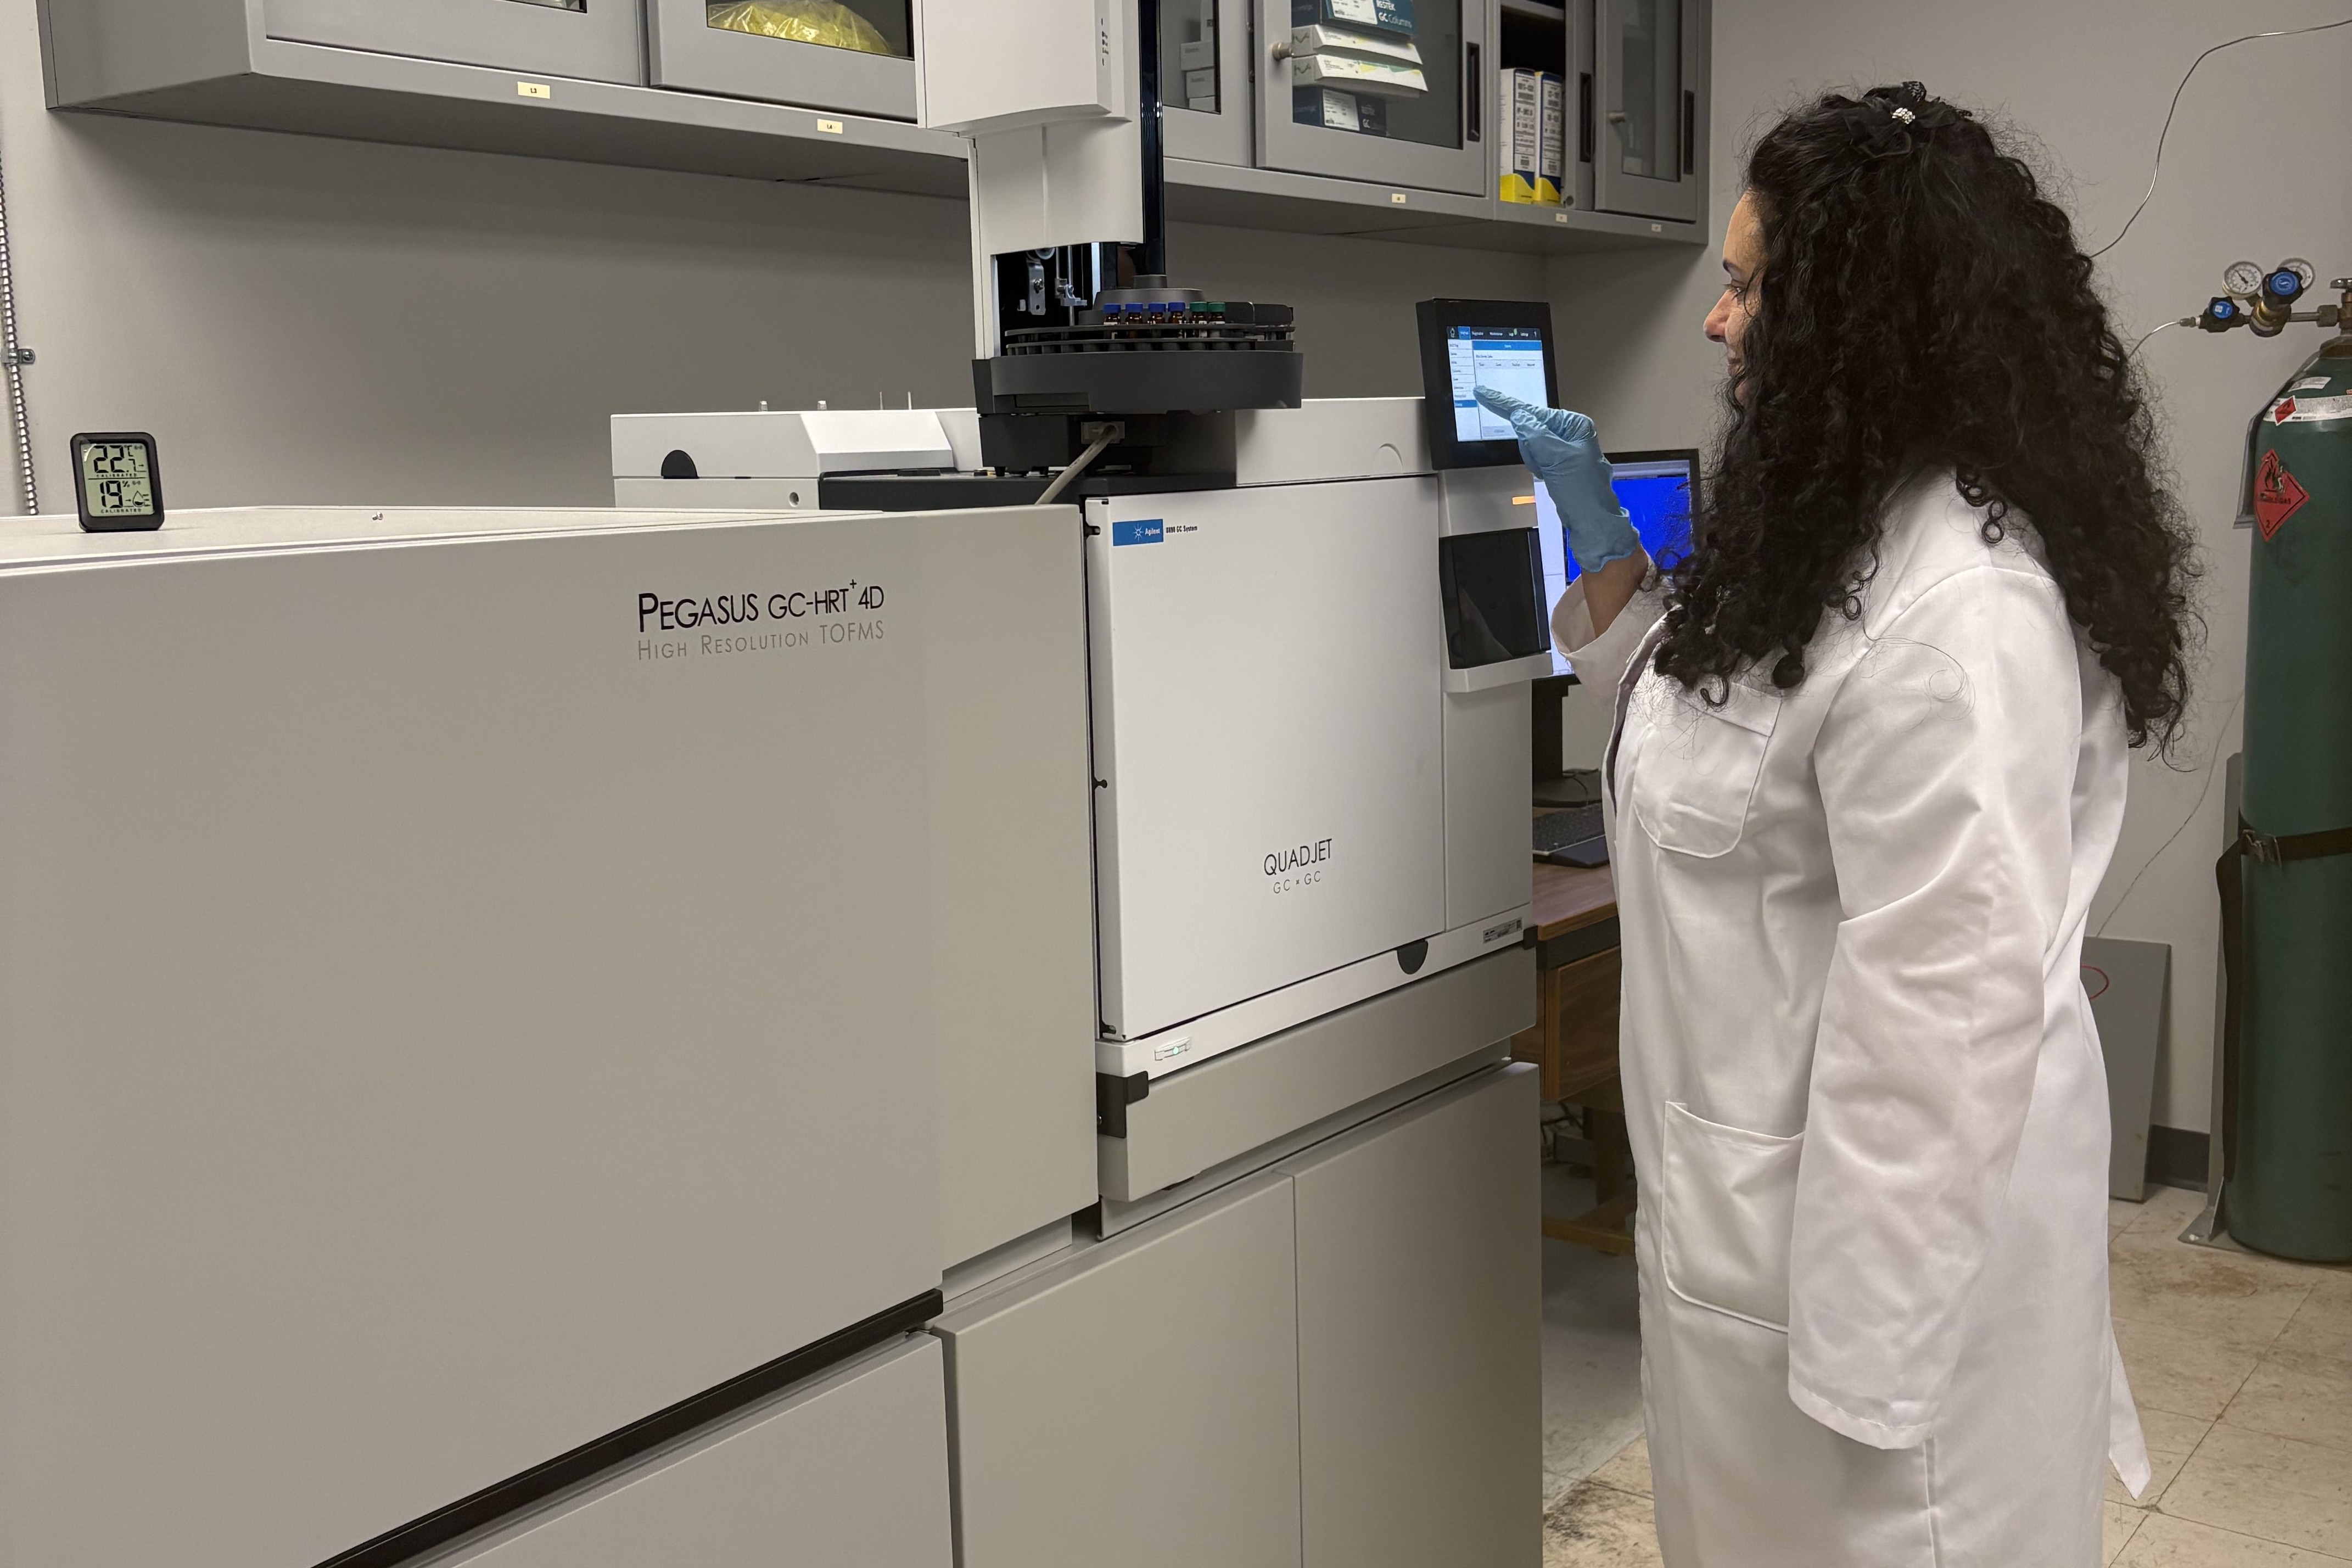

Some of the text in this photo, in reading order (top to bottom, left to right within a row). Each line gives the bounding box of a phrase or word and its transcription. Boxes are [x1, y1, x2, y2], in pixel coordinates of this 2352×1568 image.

[1379, 12, 1388, 22] GC
[1145, 528, 1160, 536] Agilent
[1183, 524, 1197, 533] System
[638, 592, 759, 632] PEGASUS
[858, 585, 884, 611] 4D
[638, 620, 884, 660] HIGH RESOLUTION TOFMS
[1264, 838, 1332, 876] QUADJET
